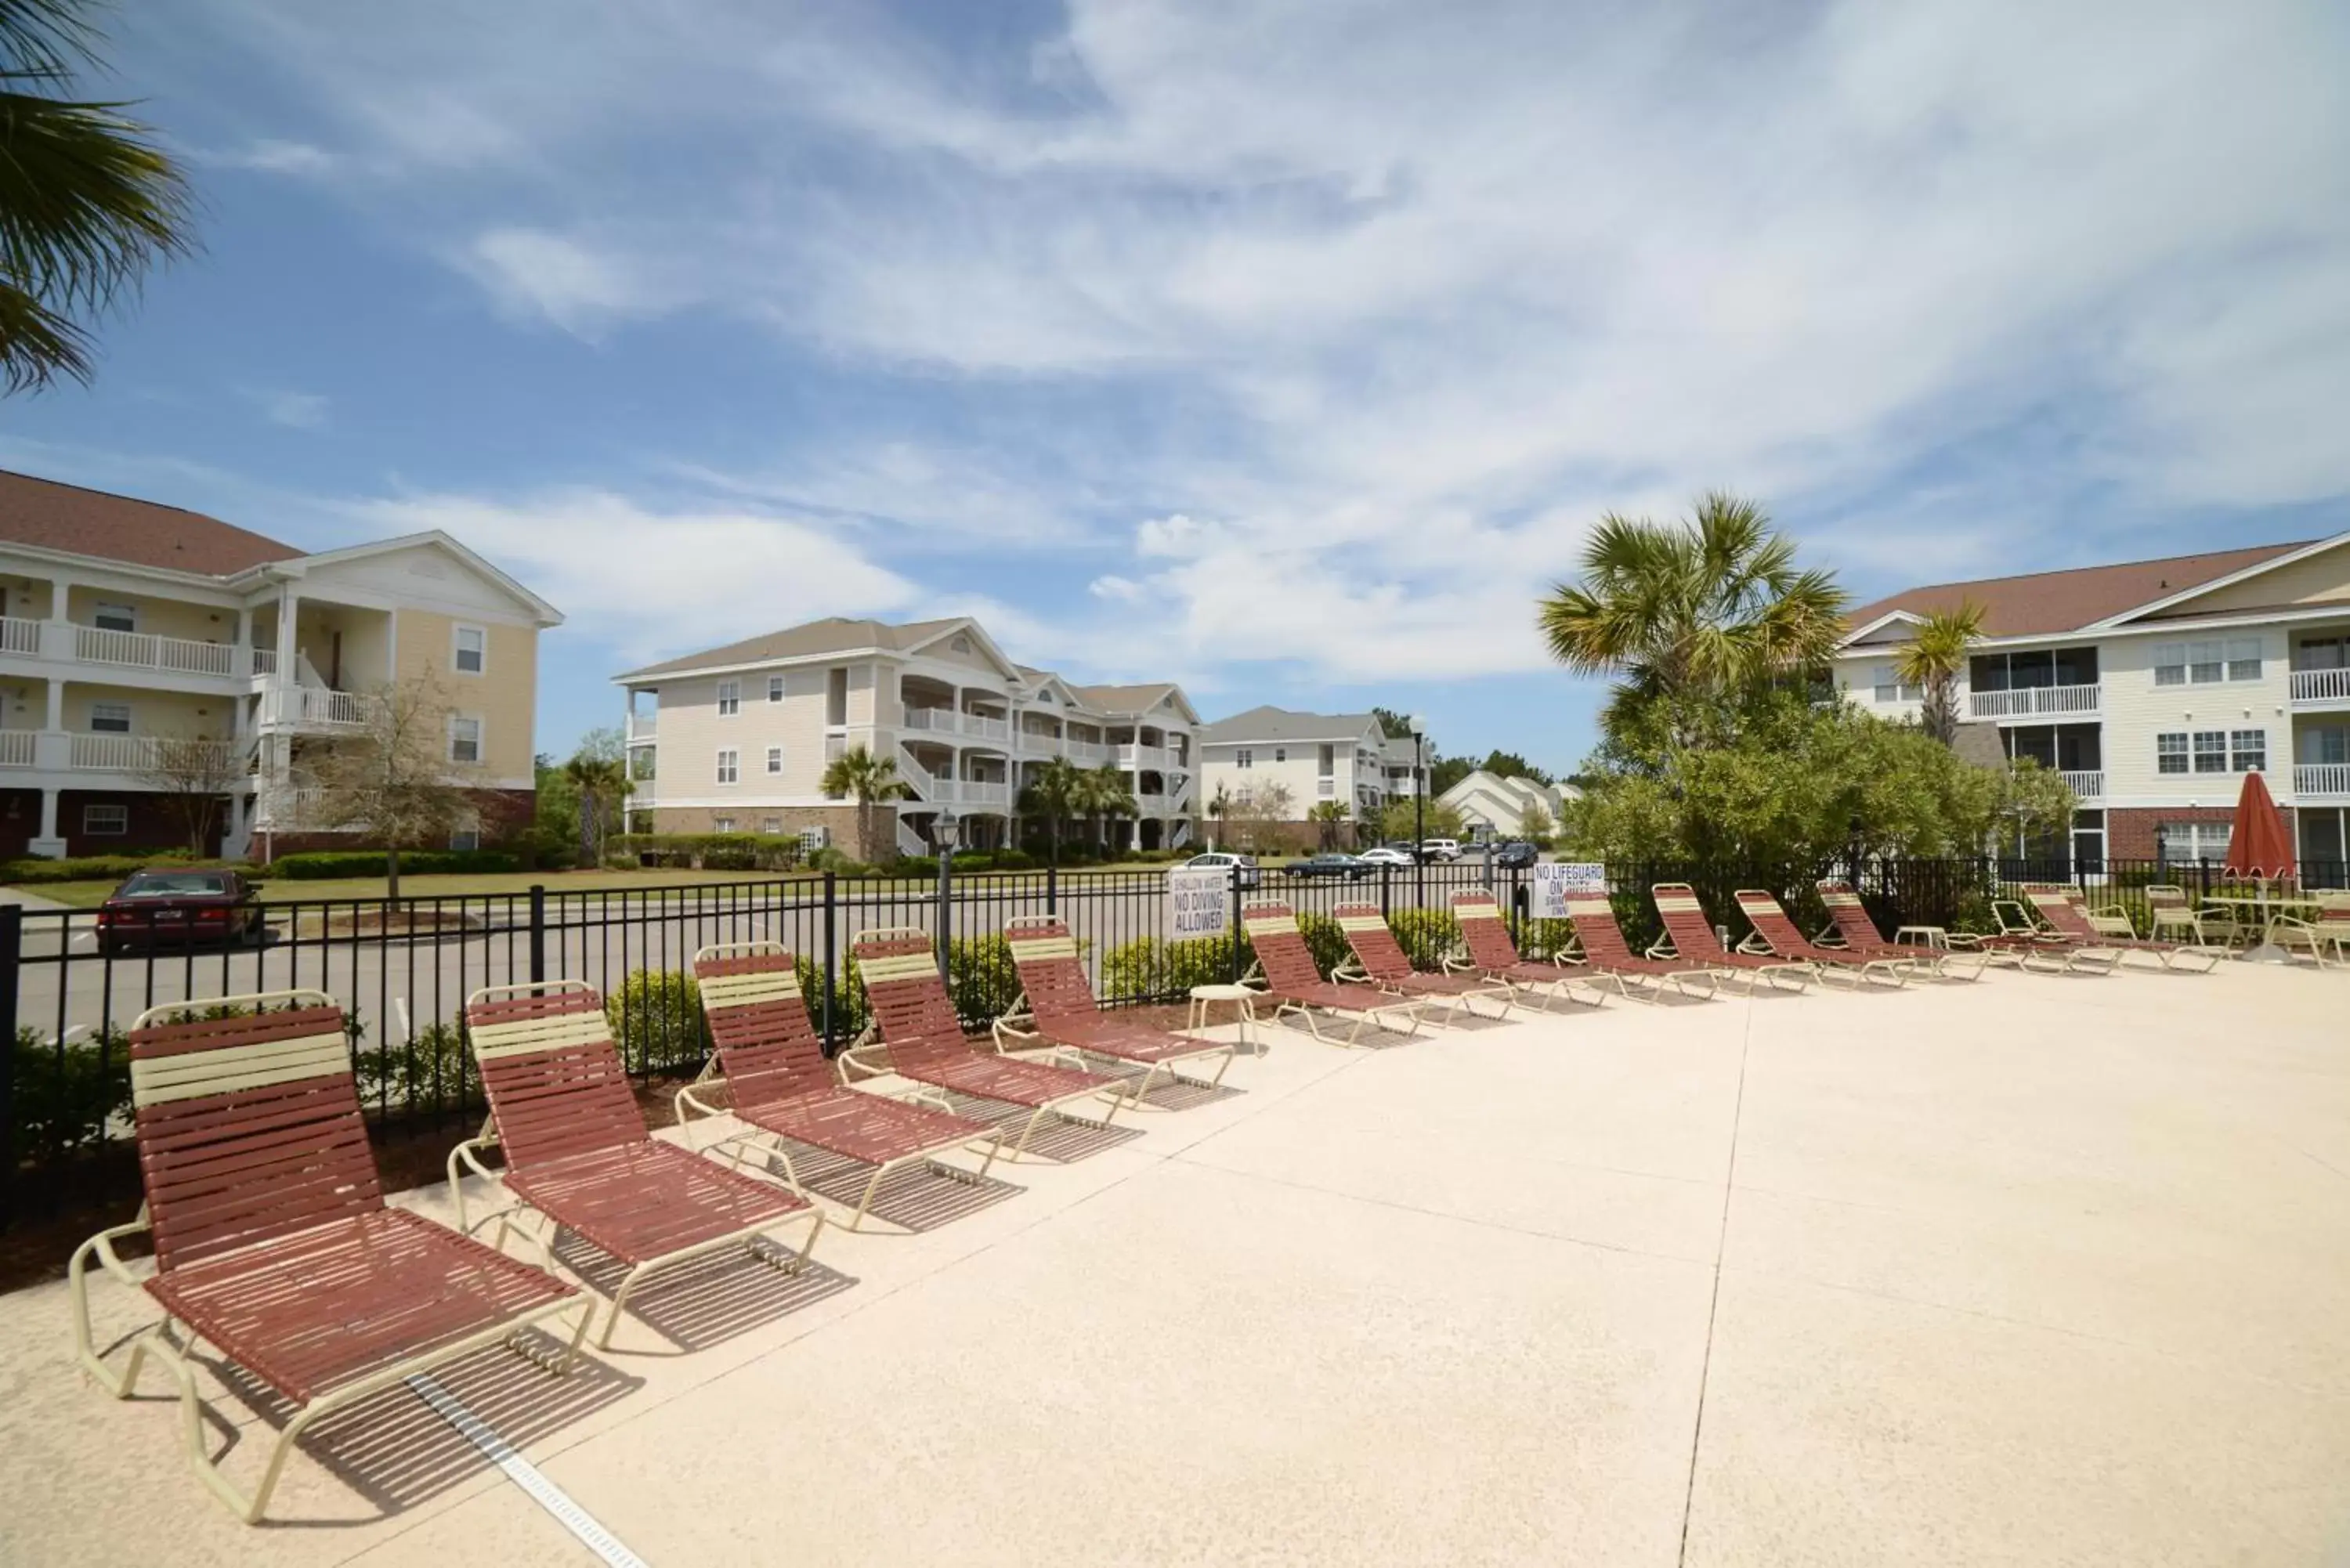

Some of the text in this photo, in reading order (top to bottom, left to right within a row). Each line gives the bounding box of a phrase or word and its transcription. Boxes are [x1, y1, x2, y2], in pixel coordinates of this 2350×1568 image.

[1536, 865, 1602, 880] NO LIFEGUARD
[1550, 880, 1563, 894] ON
[1175, 891, 1223, 912] NO DIVING
[1176, 911, 1222, 933] ALLOWED
